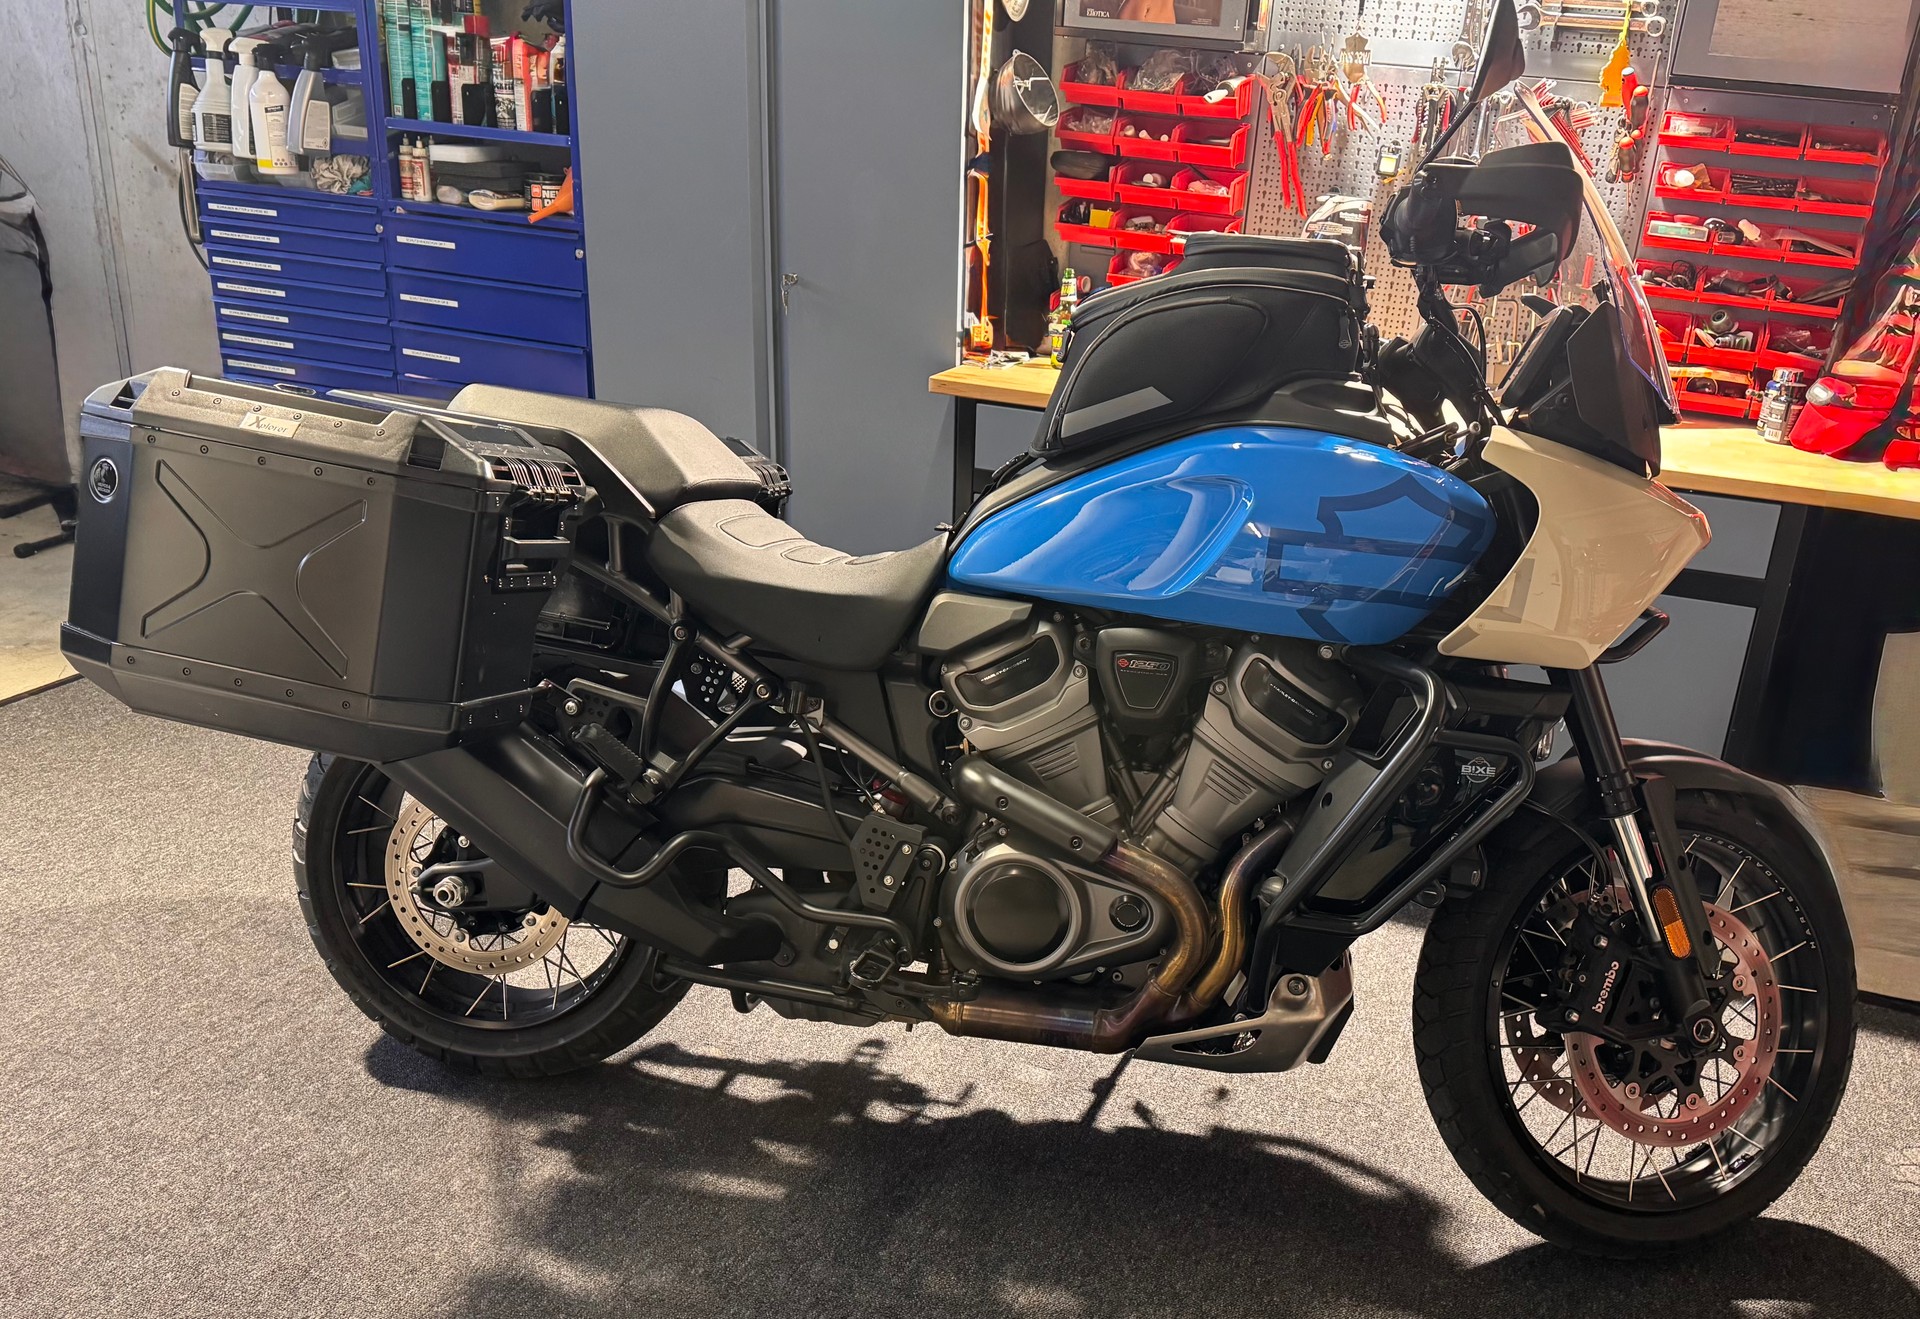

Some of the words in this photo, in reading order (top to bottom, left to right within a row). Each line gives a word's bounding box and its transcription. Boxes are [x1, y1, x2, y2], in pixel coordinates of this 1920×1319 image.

[1129, 659, 1171, 671] 1250
[1461, 764, 1497, 775] BIXE
[1591, 960, 1620, 1014] brembo
